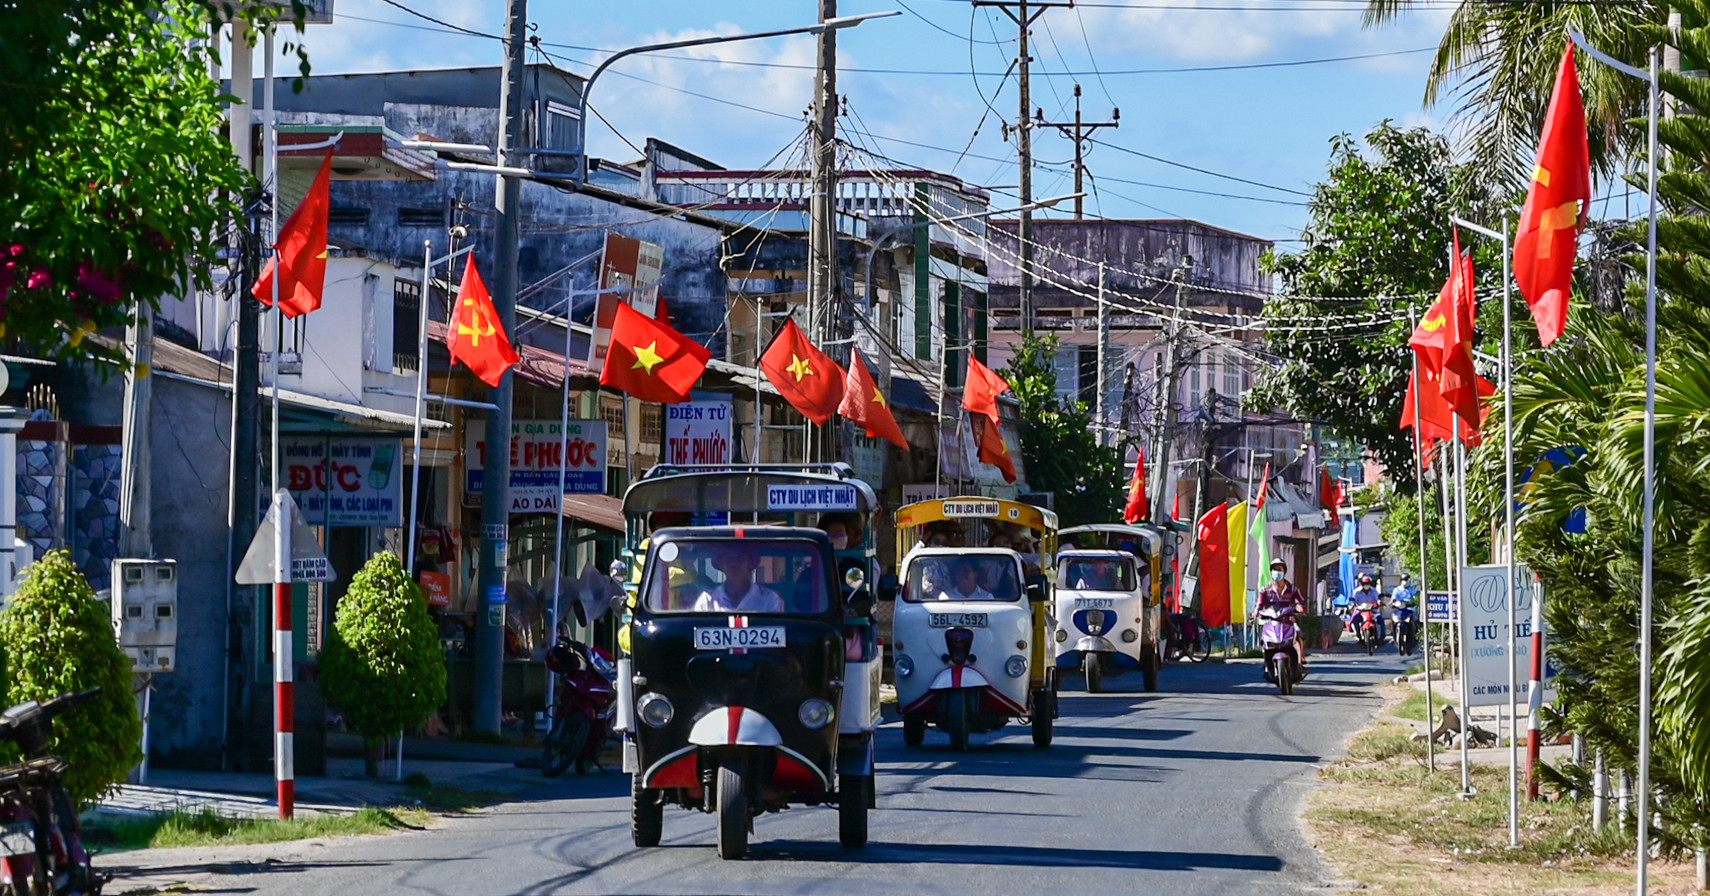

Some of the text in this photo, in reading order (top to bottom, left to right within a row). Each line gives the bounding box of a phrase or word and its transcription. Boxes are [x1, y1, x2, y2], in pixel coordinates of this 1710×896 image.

[669, 404, 727, 422] ĐIỆN TỬ
[525, 424, 544, 434] GIA
[352, 443, 371, 457] TÍNH
[476, 435, 598, 469] TẾ PHƯỚC
[288, 459, 362, 492] ĐỨC
[346, 494, 361, 511] CÁC
[380, 498, 393, 511] PIN
[769, 486, 854, 507] CTY DU LỊCH VIỆT NHẬT
[943, 502, 998, 516] CTY DU LỊCH VIỆT NHẬT
[701, 629, 780, 647] 63N-0294
[1474, 620, 1498, 640] HỦ
[1473, 684, 1490, 695] CÁC
[1490, 683, 1502, 694] MÓN
